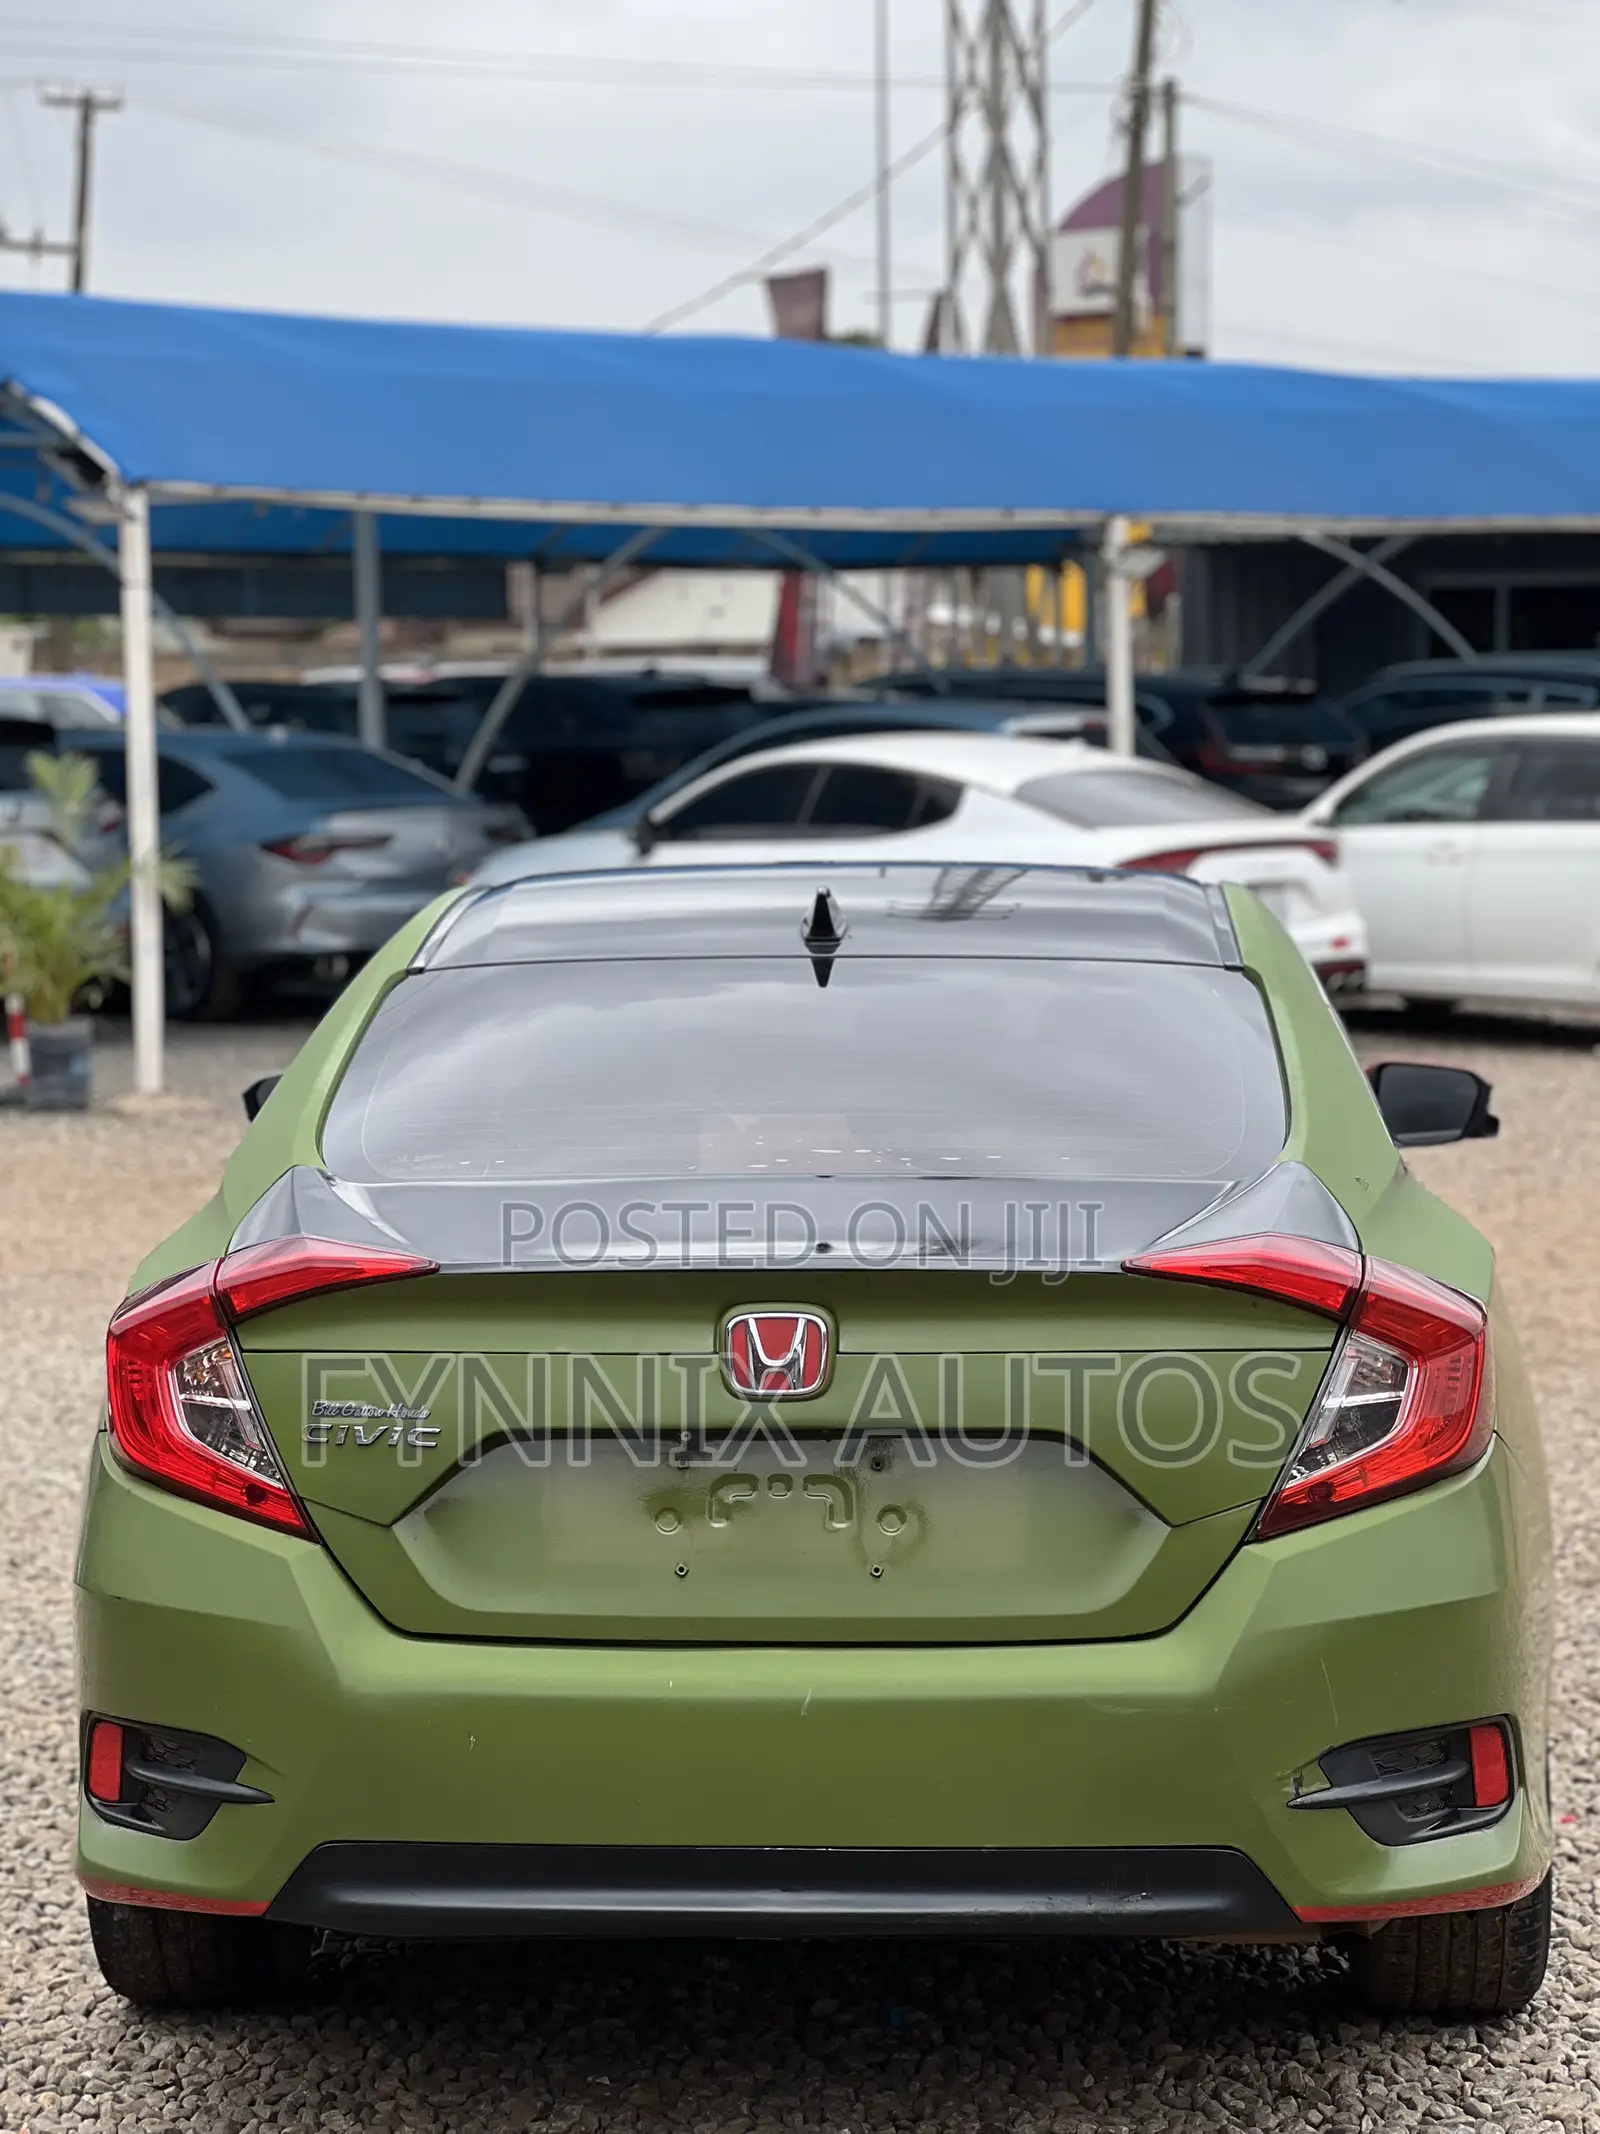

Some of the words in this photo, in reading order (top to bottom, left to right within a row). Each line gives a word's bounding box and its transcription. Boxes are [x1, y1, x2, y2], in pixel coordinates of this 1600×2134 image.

[311, 1400, 340, 1416] Bill
[385, 1403, 431, 1419] Honda
[301, 1423, 442, 1447] CIVIC
